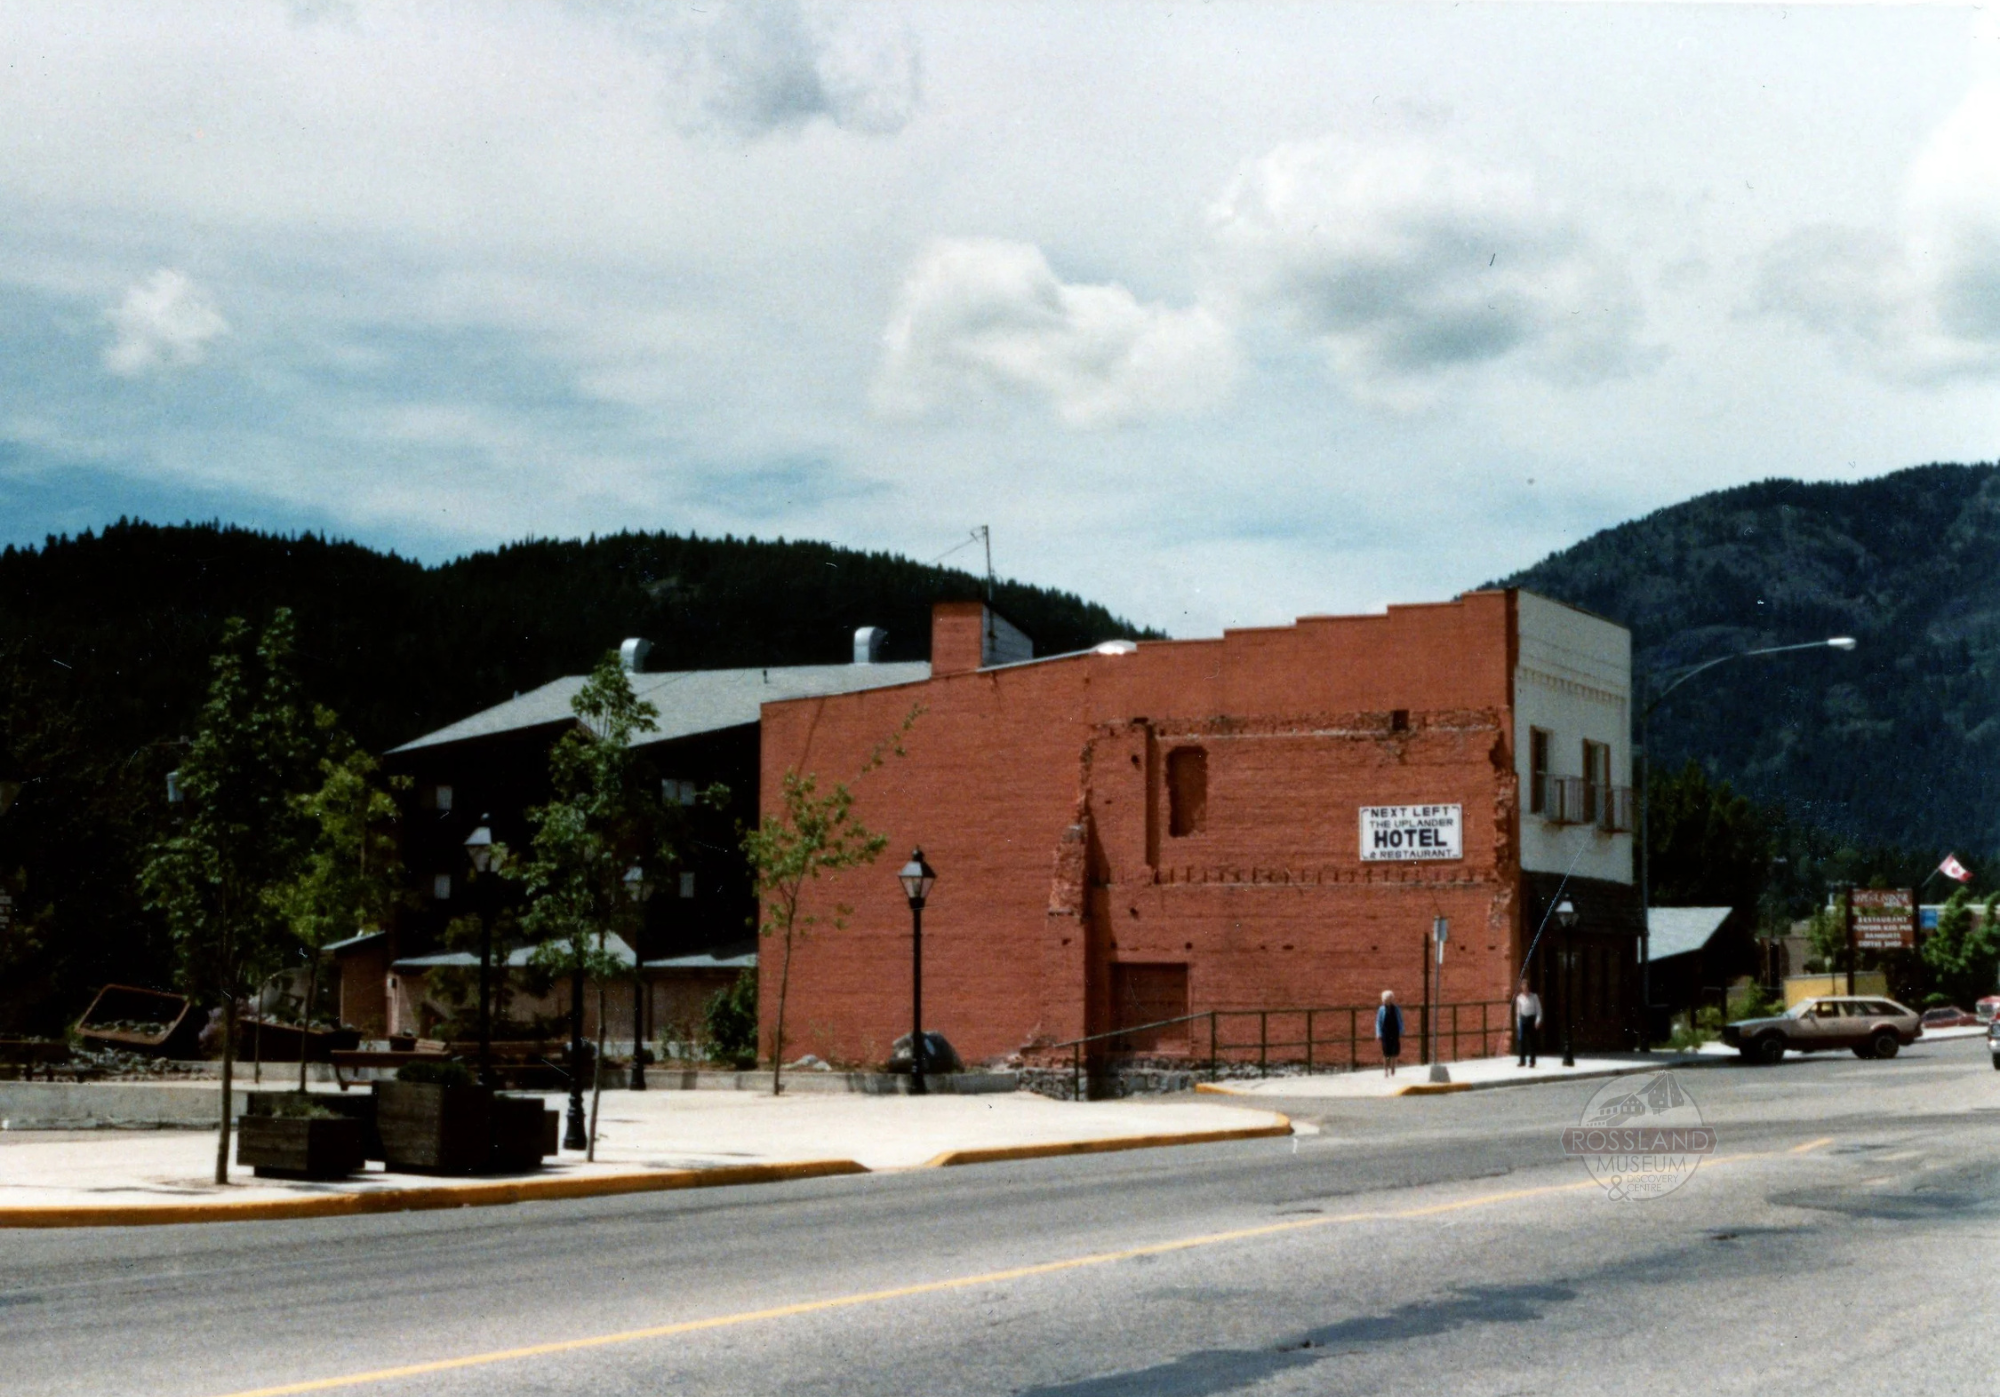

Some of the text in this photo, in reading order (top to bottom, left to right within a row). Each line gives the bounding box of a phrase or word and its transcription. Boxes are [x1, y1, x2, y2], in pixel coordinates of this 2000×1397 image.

[1371, 806, 1449, 818] NEXT LEFT
[1370, 818, 1454, 829] THE UPLANDER
[1374, 828, 1447, 848] HOTEL
[1380, 849, 1452, 859] RESTAURANT
